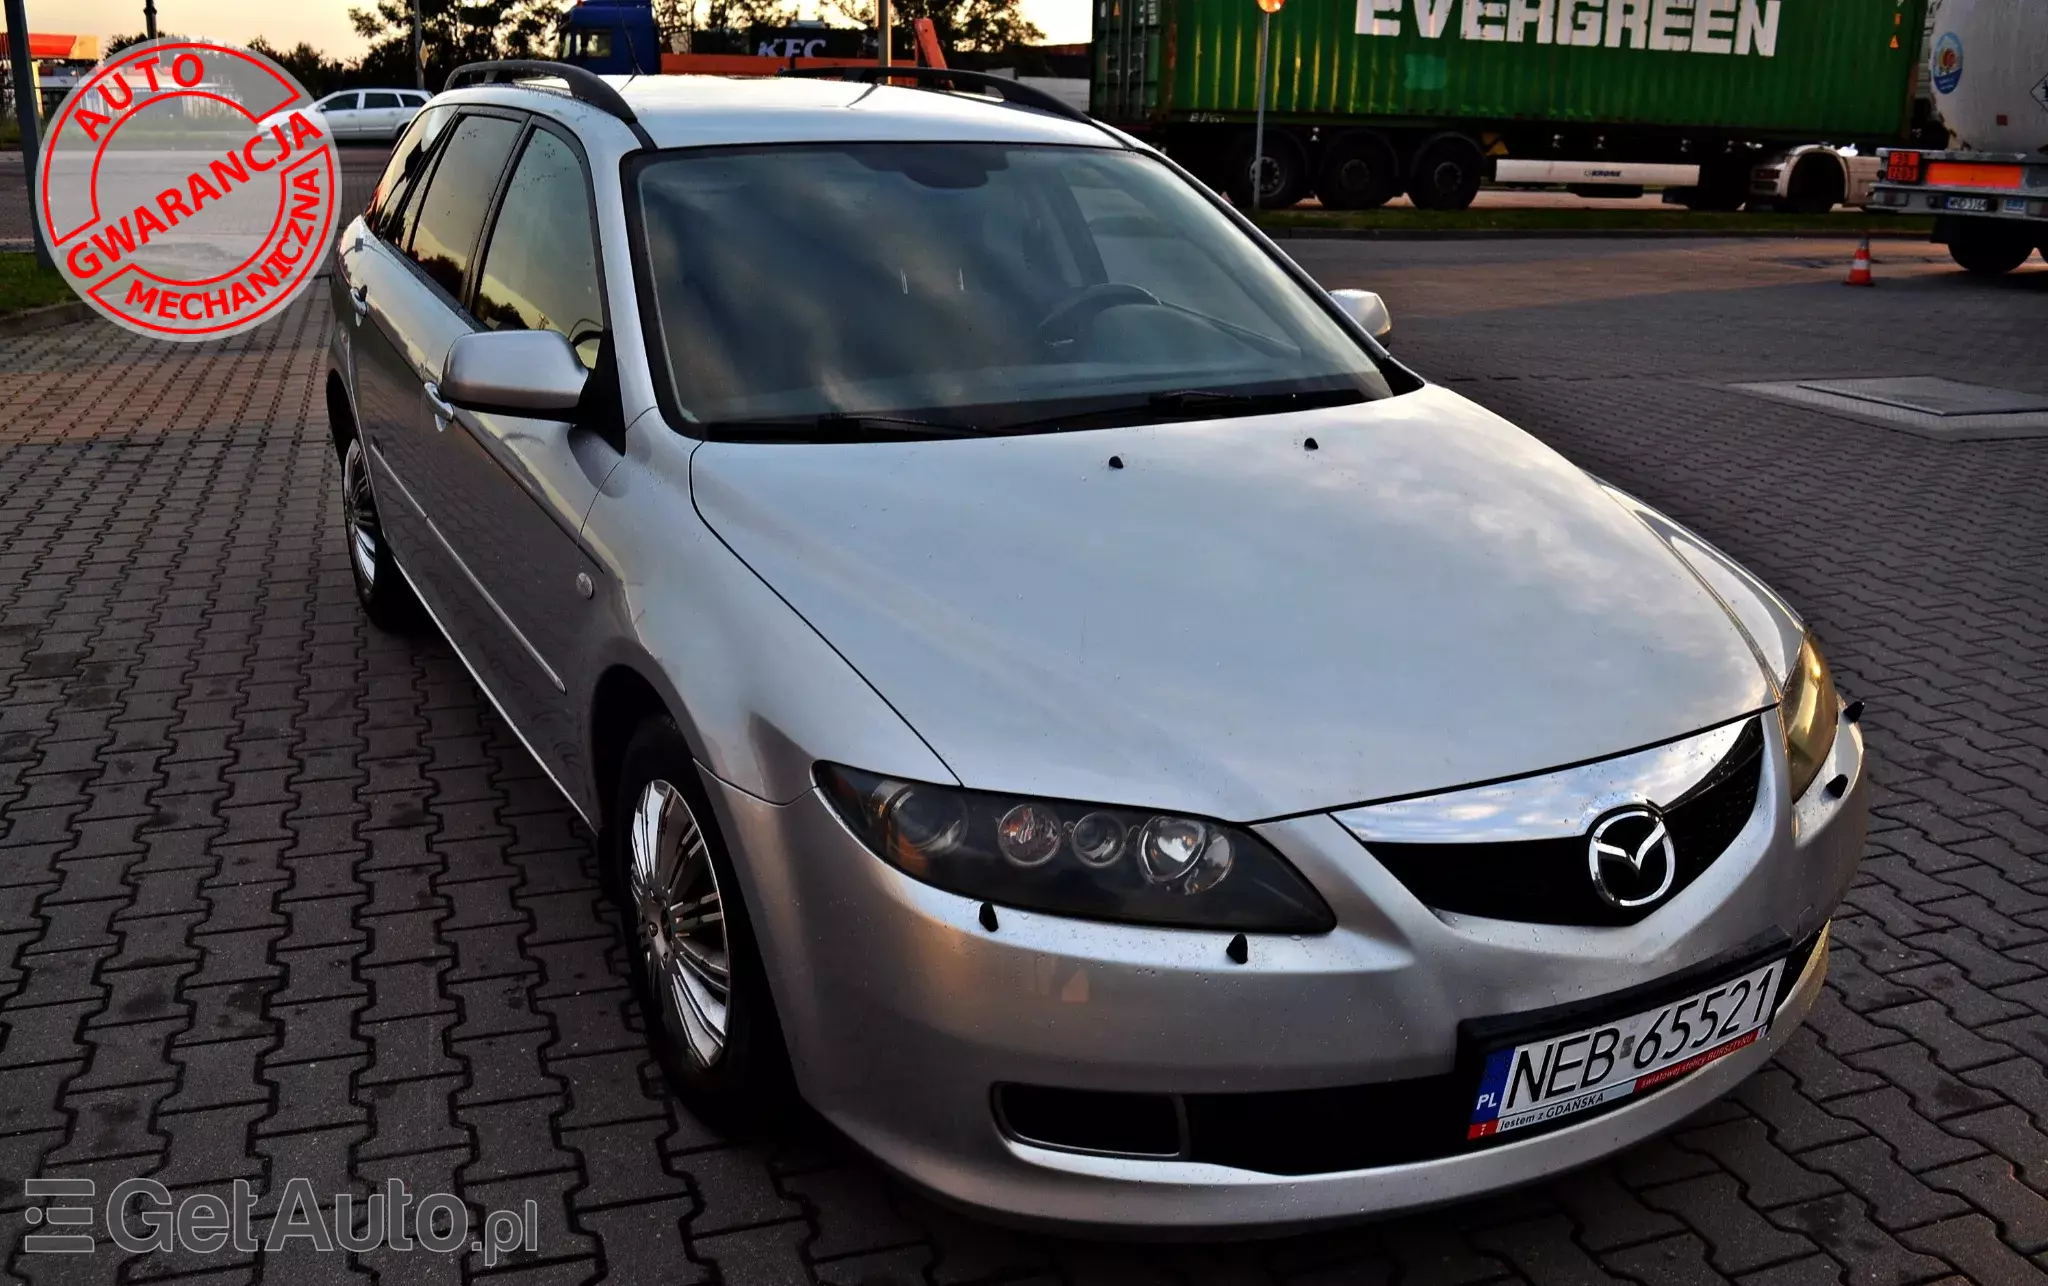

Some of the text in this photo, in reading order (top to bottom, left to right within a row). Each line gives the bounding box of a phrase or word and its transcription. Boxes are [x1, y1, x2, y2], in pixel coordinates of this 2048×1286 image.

[1354, 0, 1781, 57] EVERGREEN
[757, 38, 826, 58] KFC
[1506, 968, 1775, 1109] NEB 65521
[1476, 1094, 1497, 1111] PL
[1538, 1112, 1544, 1121] z
[1546, 1093, 1605, 1119] GDAŃSKA
